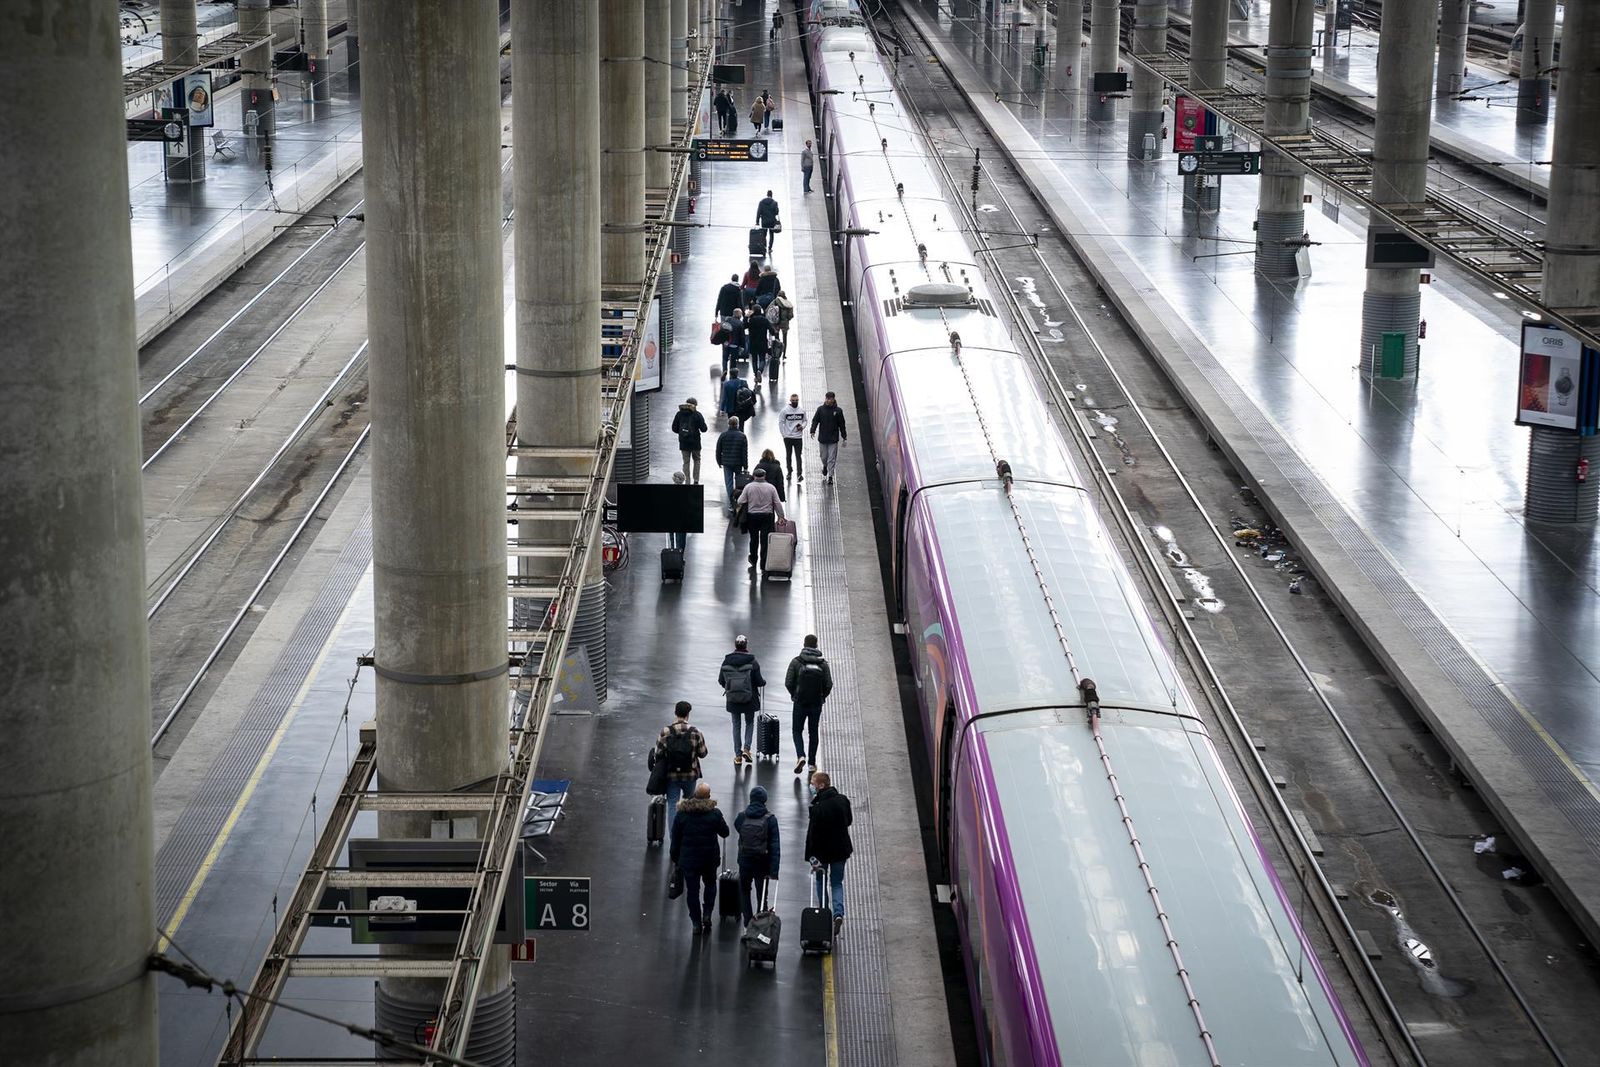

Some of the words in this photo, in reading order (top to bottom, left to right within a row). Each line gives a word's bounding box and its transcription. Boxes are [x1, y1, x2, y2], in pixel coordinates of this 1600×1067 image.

[1244, 161, 1251, 172] 9
[1542, 336, 1563, 346] ORIS
[333, 900, 350, 925] A
[540, 903, 557, 927] A
[571, 903, 588, 928] 8
